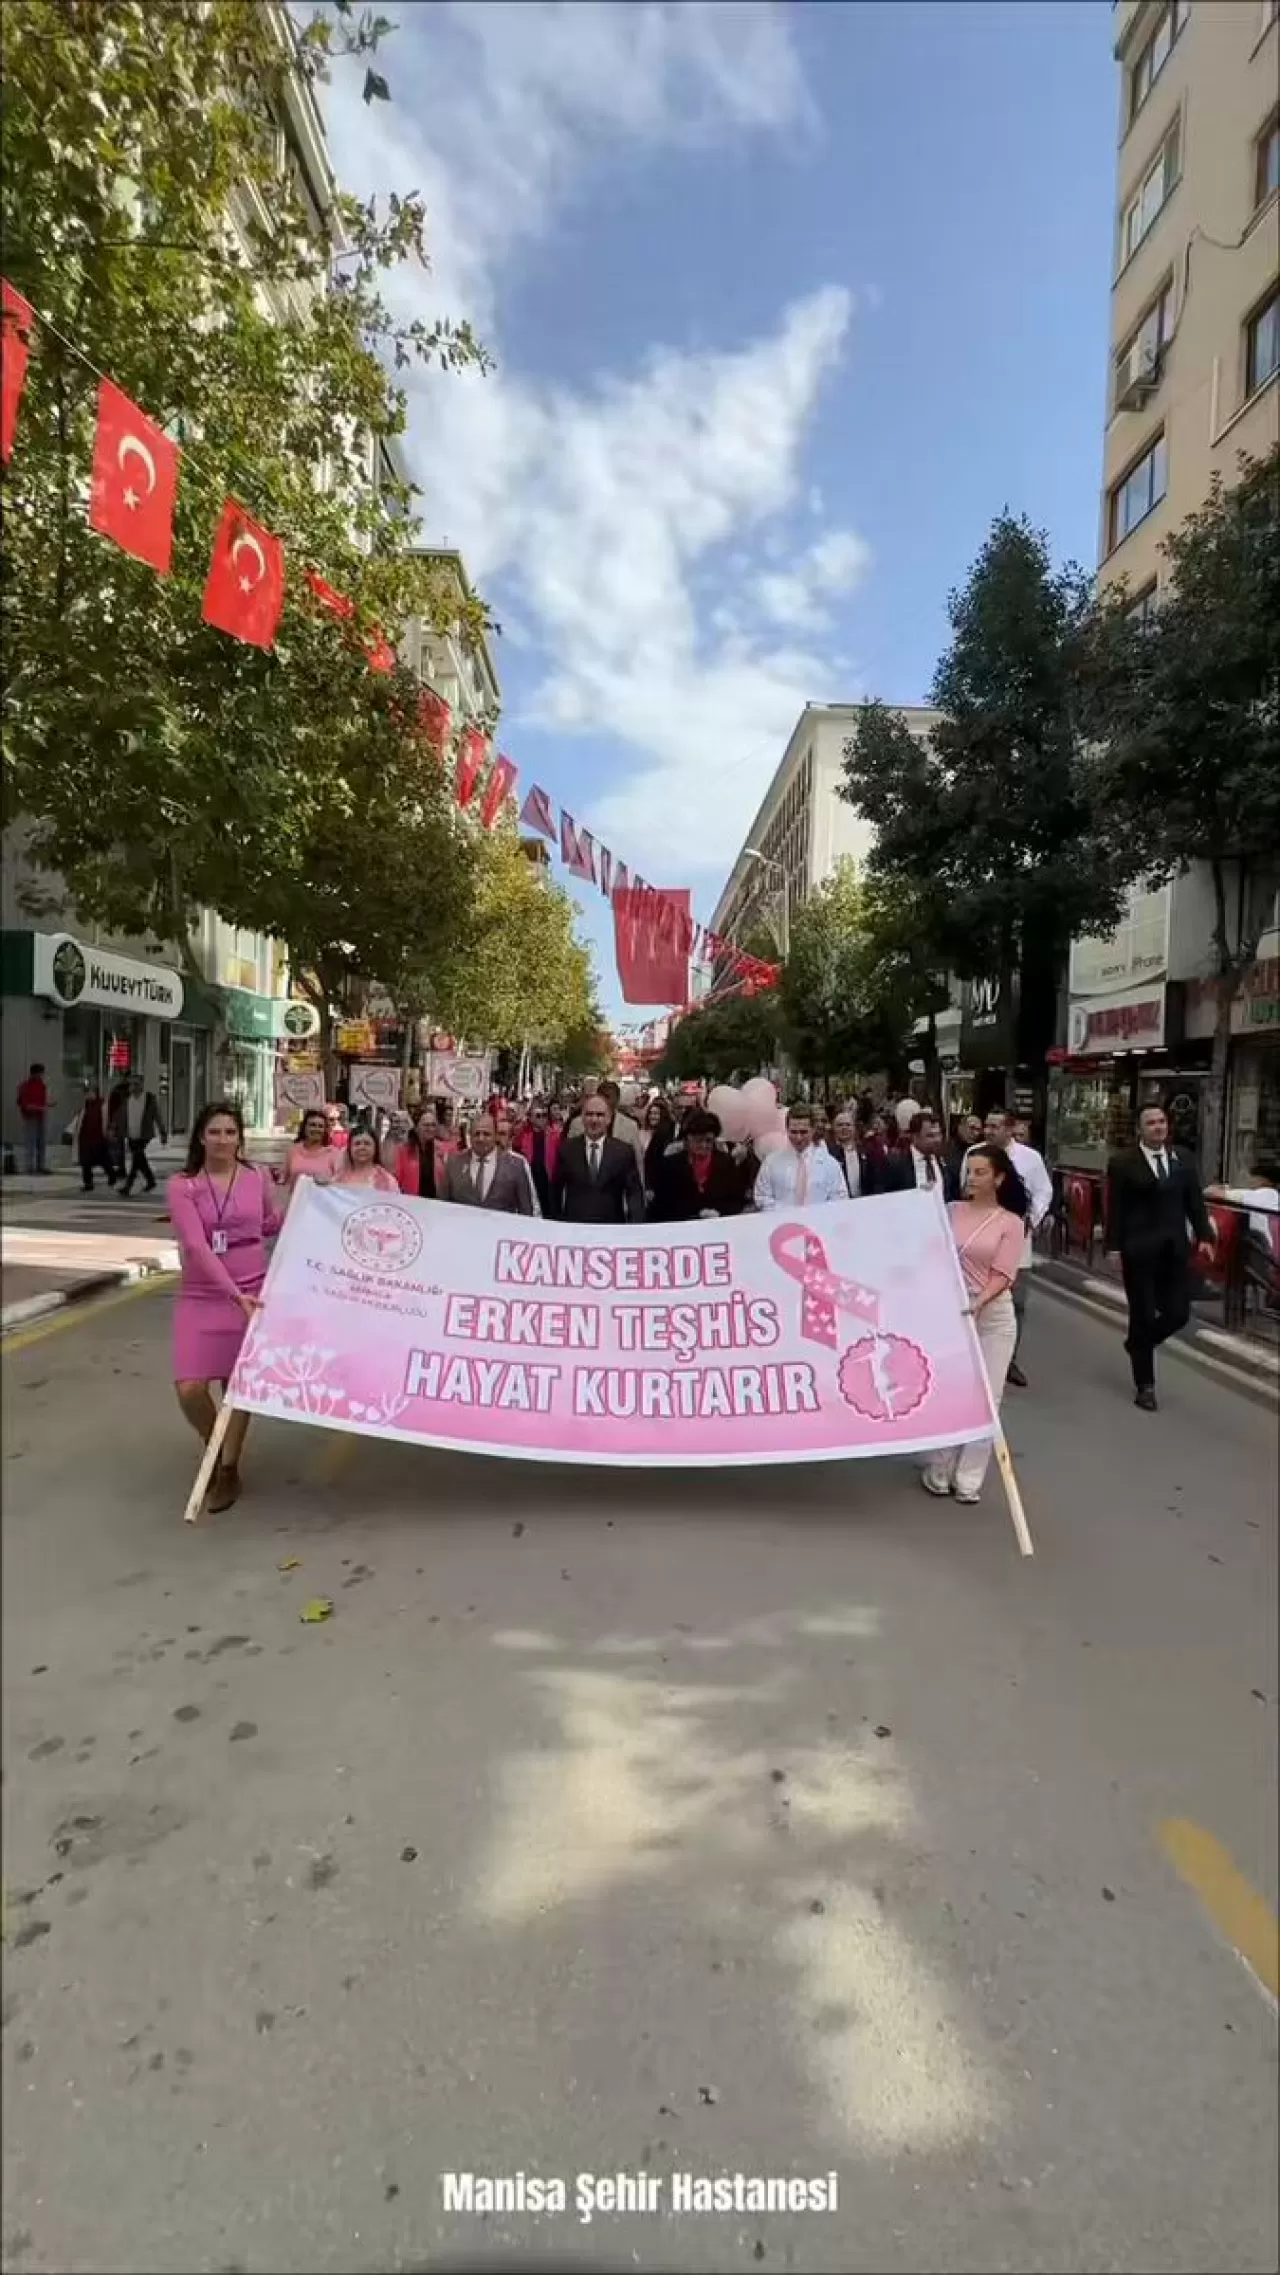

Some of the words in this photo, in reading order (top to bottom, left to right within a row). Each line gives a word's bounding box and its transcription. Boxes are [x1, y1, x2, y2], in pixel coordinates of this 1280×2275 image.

[495, 1240, 731, 1289] KANSERDE
[444, 1293, 600, 1350] ERKEN
[612, 1291, 780, 1362] TEŞHİS
[404, 1348, 561, 1412] HAYAT
[573, 1362, 821, 1418] KURTARIR
